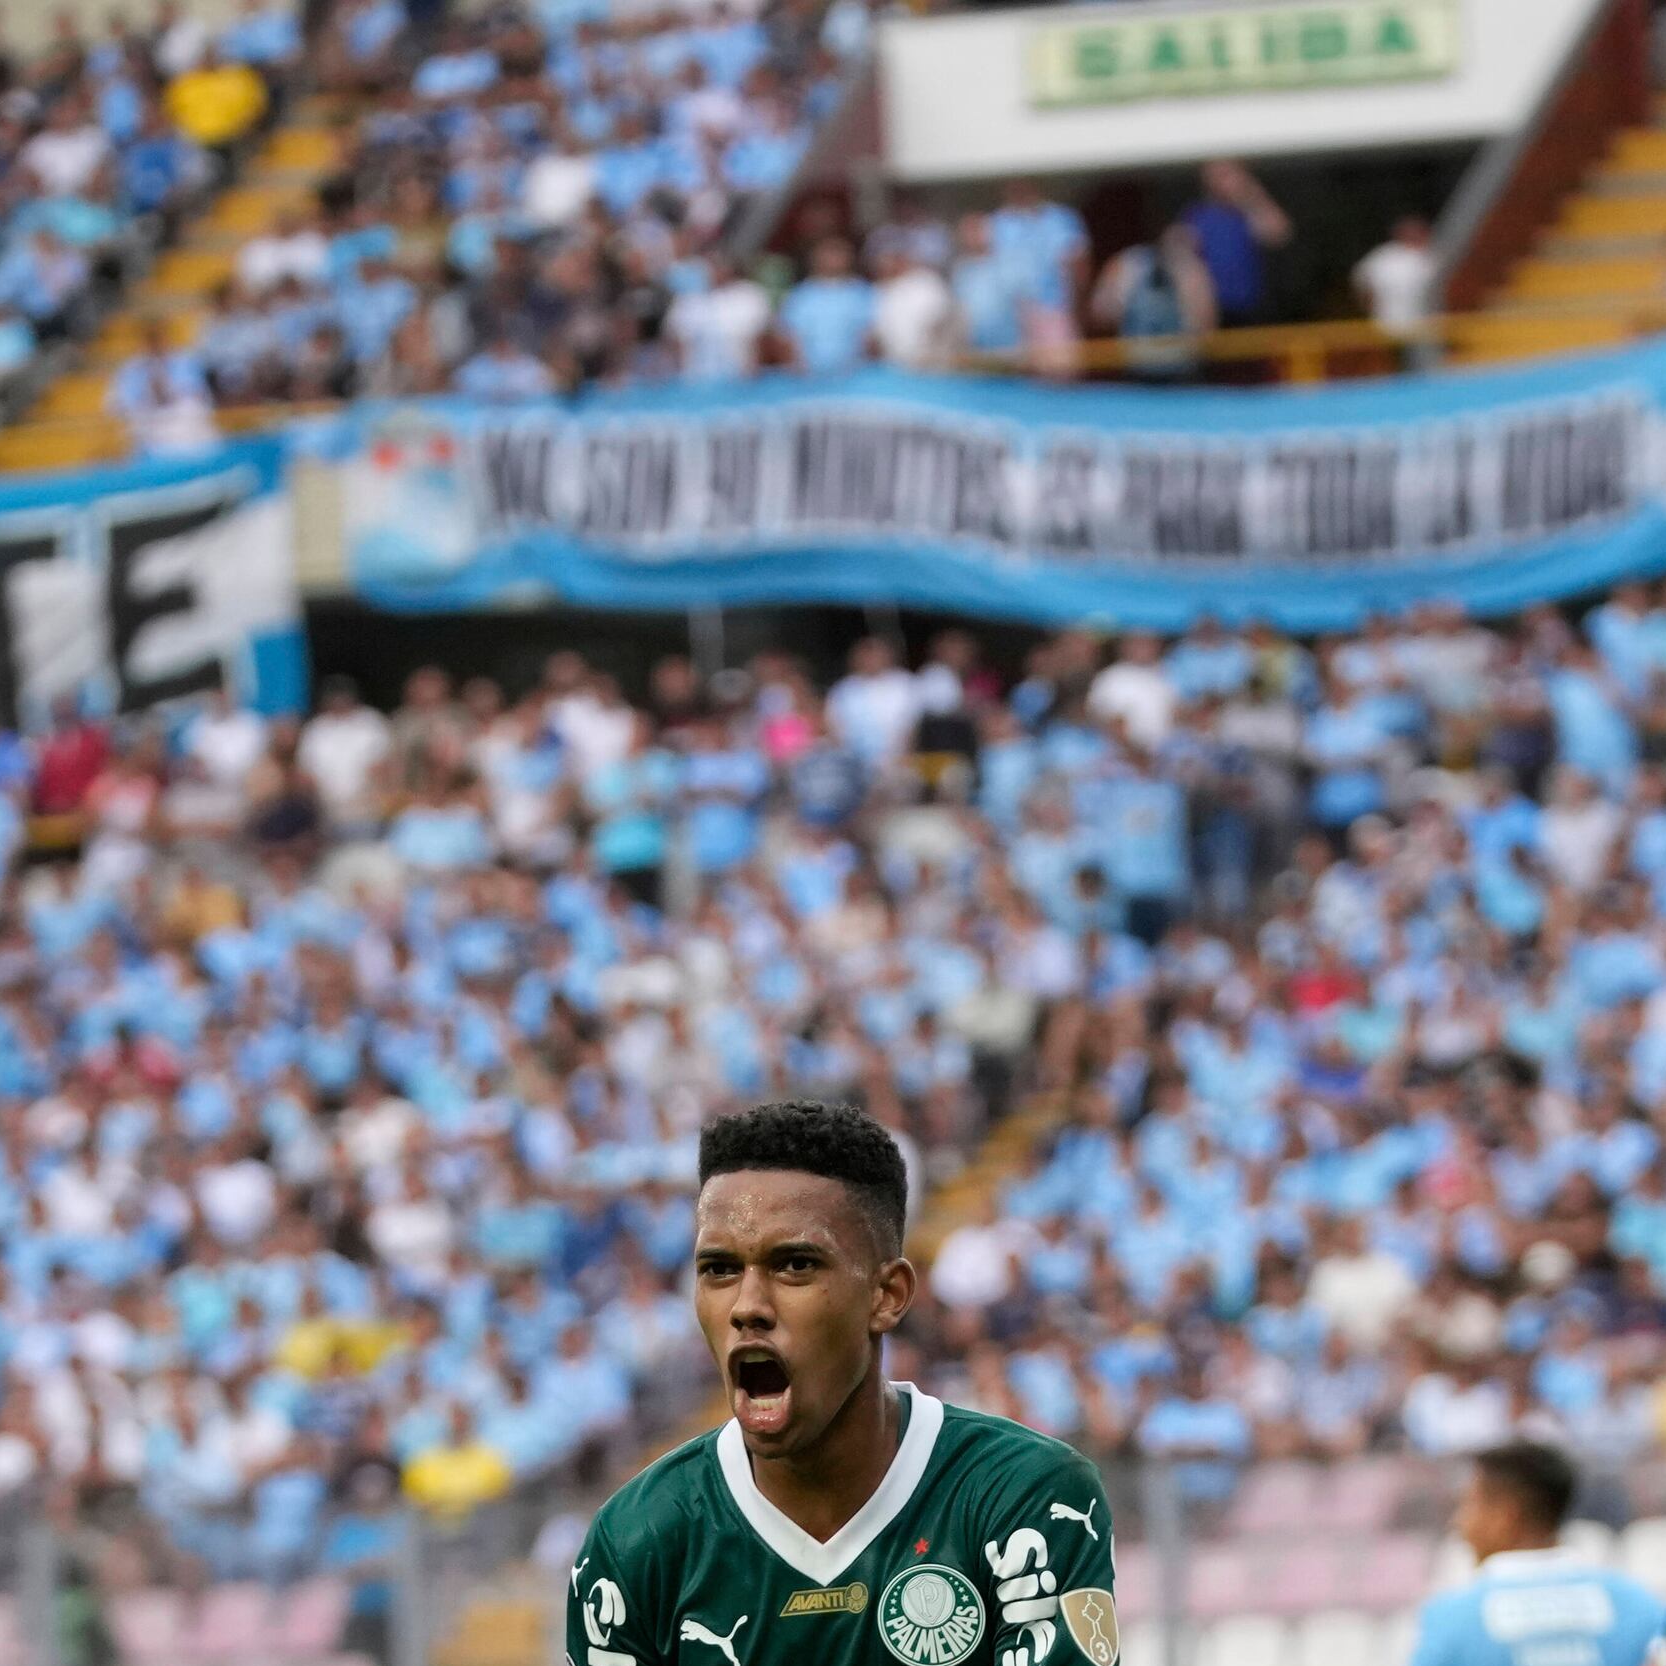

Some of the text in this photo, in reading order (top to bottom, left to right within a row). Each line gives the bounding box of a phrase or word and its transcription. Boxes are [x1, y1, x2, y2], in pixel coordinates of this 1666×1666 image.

[1075, 8, 1419, 80] SALIDA
[788, 1591, 844, 1612] AVANTI
[886, 1605, 979, 1665] PALMEIRAS
[1095, 1641, 1108, 1662] 3
